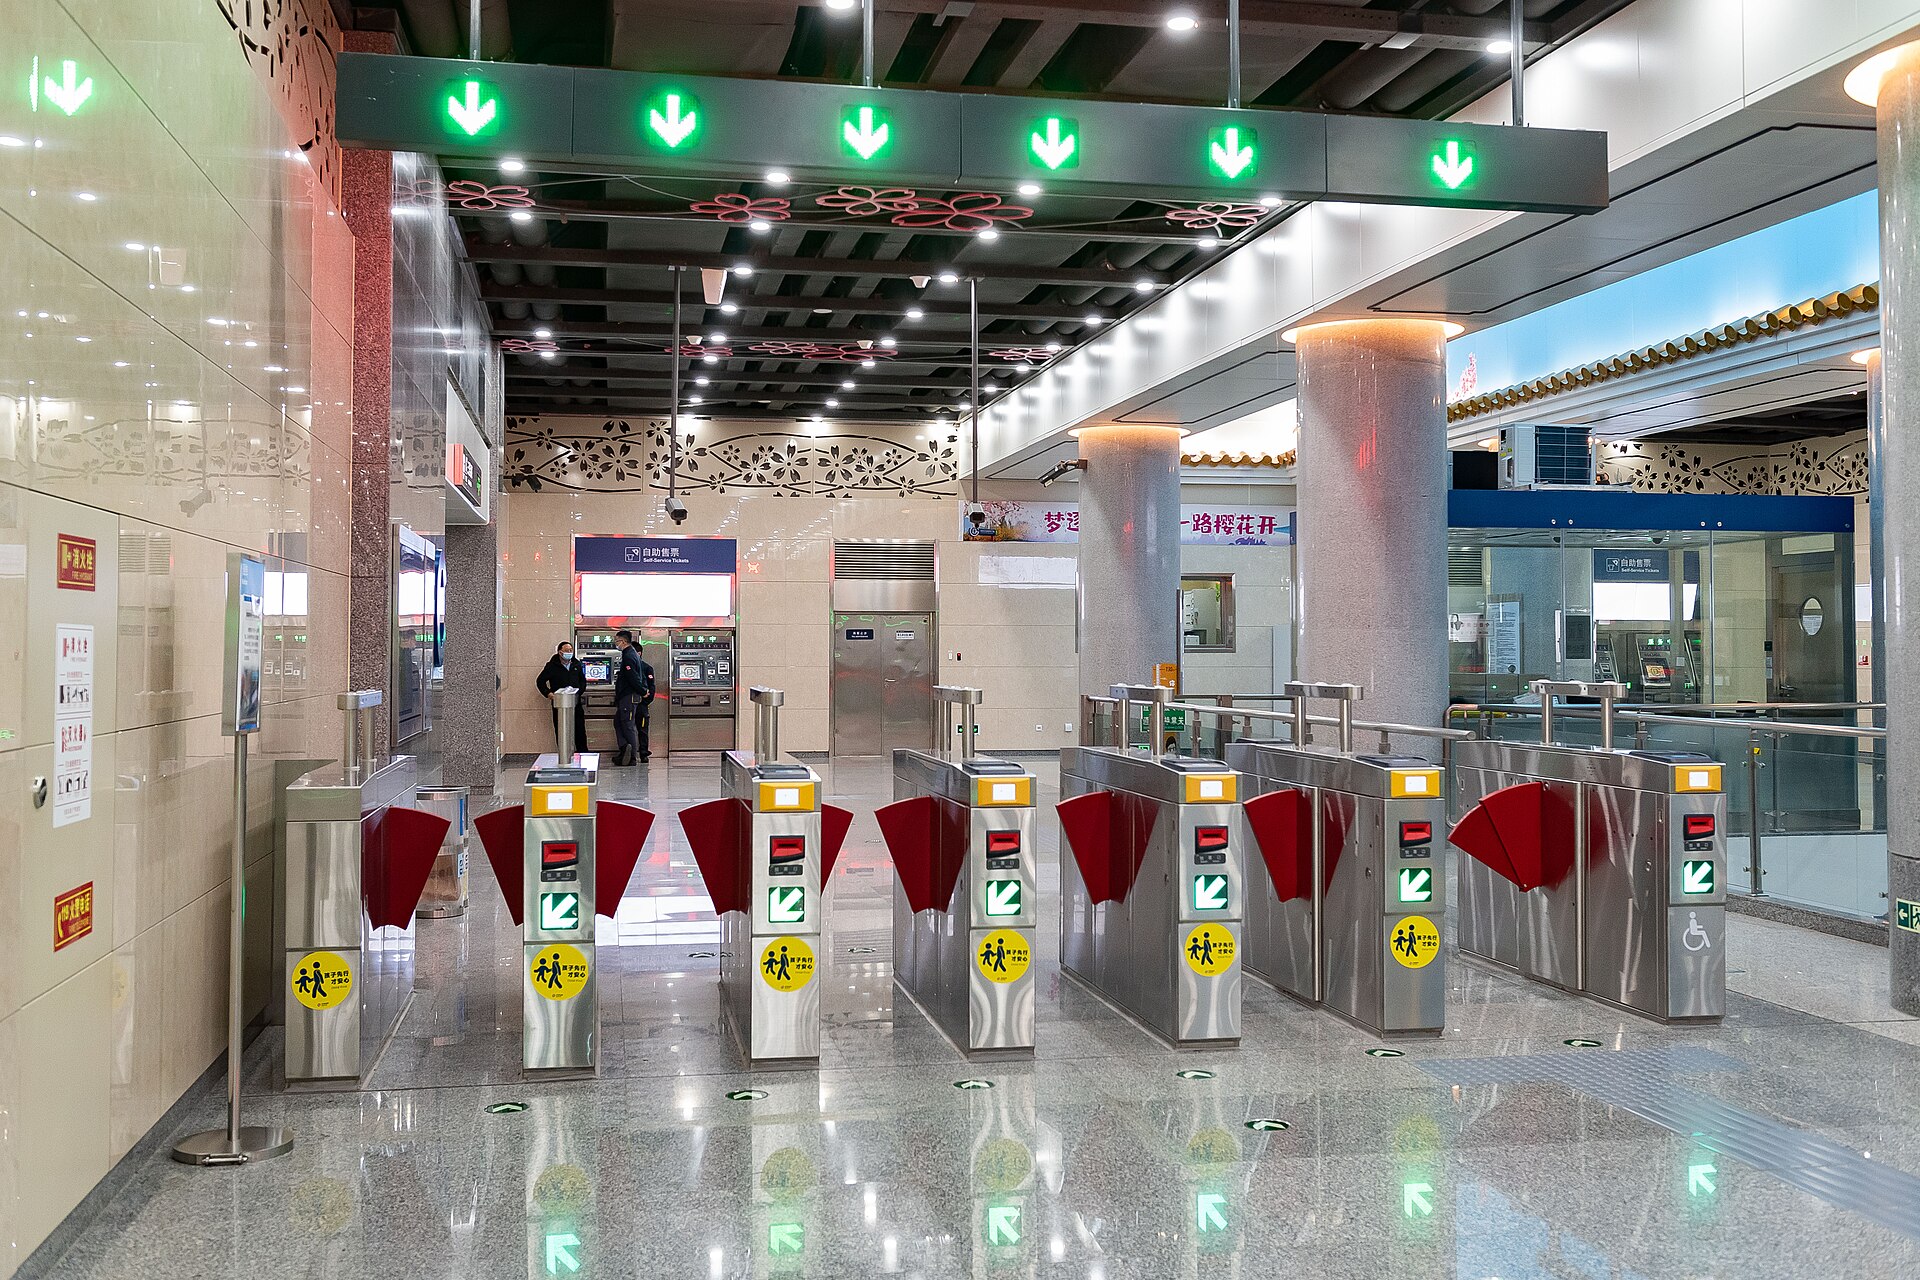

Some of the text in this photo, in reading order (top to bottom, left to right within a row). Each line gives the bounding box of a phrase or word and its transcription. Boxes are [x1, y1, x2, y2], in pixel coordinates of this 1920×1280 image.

[643, 547, 680, 557] 自助售票
[72, 547, 93, 570] 消火栓
[1621, 558, 1652, 567] 自助售票
